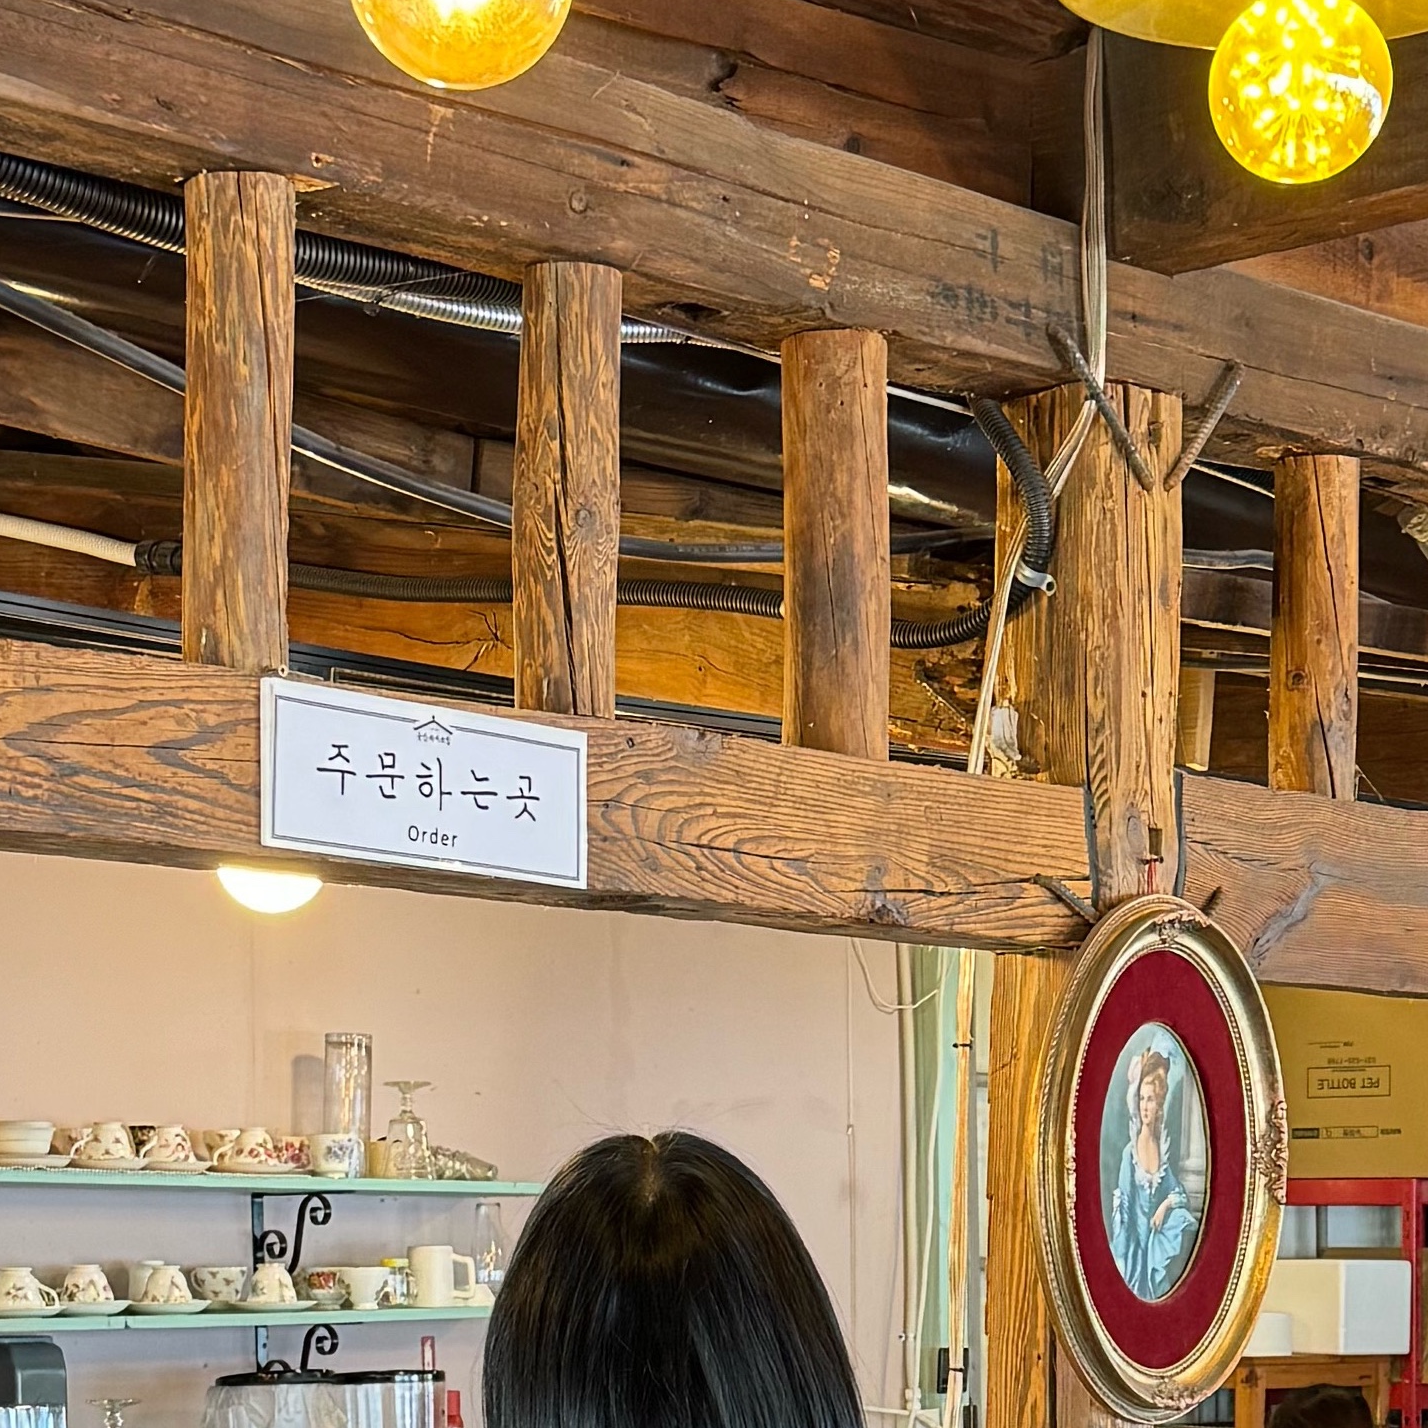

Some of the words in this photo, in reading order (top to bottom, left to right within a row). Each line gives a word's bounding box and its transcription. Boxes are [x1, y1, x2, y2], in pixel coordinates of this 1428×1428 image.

[408, 825, 458, 847] Order
[1317, 1078, 1356, 1091] BOTTLE
[1361, 1076, 1380, 1089] PET
